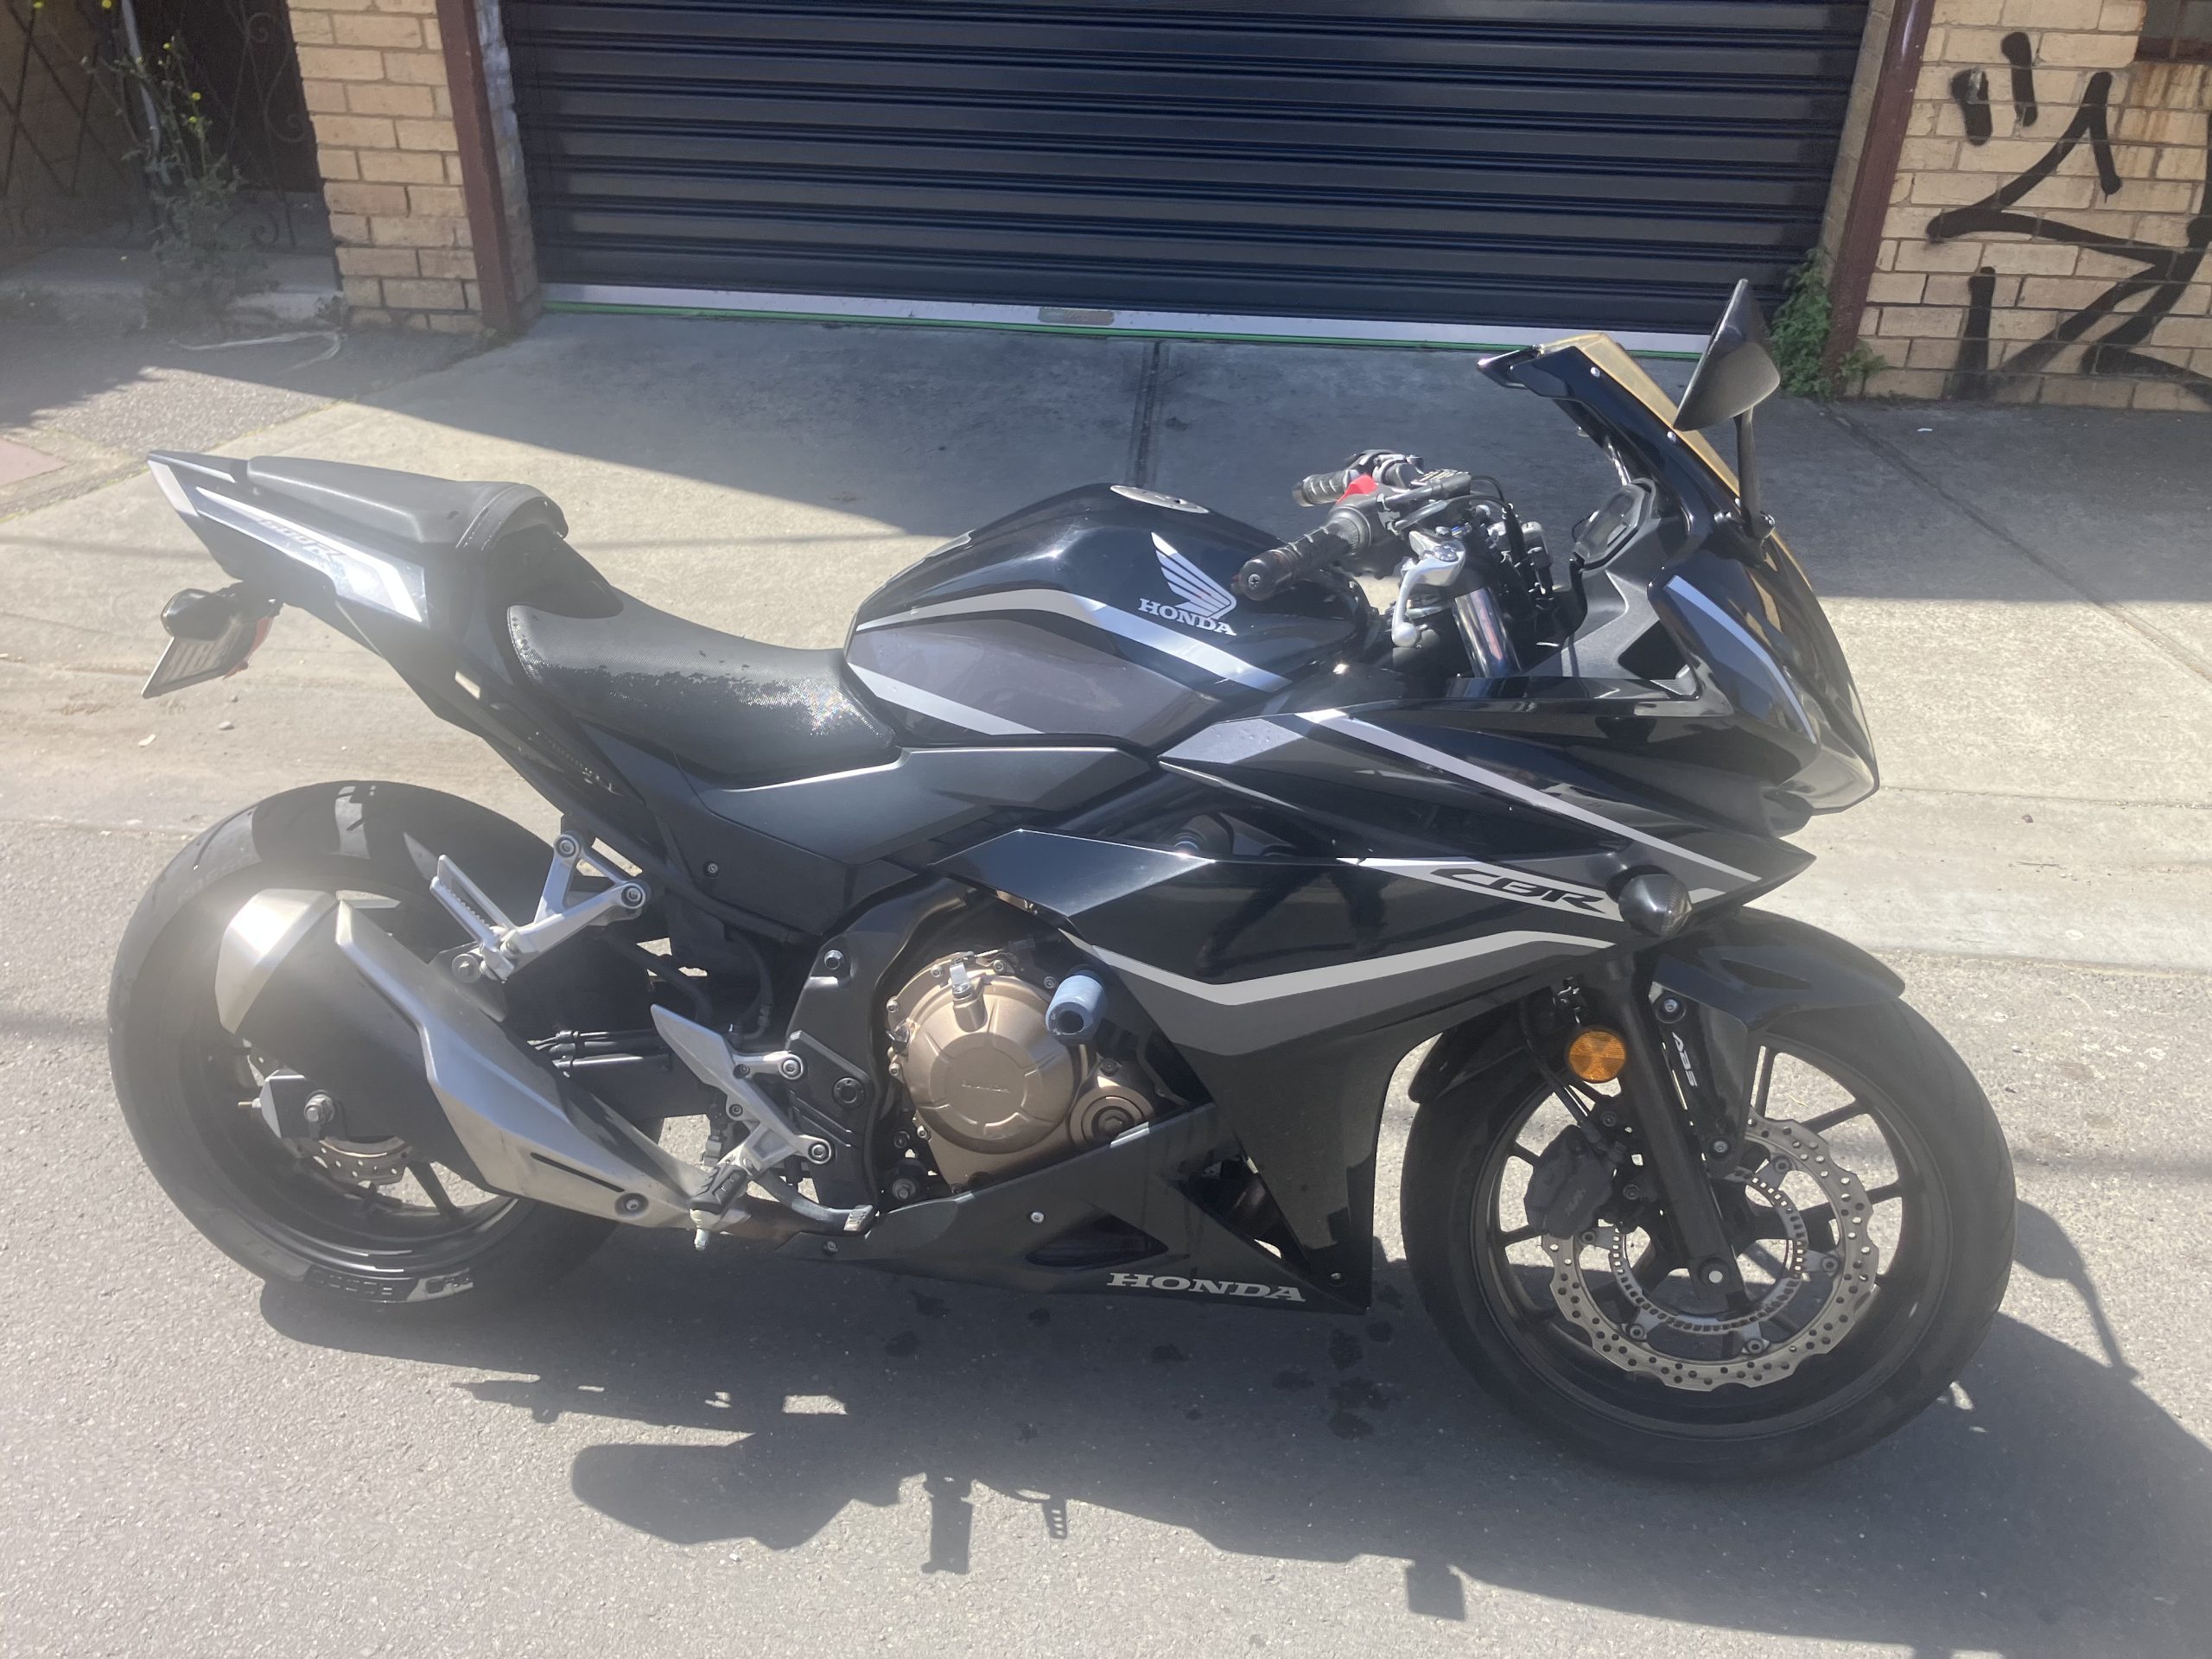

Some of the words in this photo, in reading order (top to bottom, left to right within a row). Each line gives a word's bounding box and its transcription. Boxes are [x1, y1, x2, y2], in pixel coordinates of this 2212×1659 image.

[1138, 597, 1237, 637] HONDA
[1430, 868, 1606, 914] CBR
[1671, 1032, 1698, 1088] ABS
[1106, 1272, 1306, 1302] HONDA
